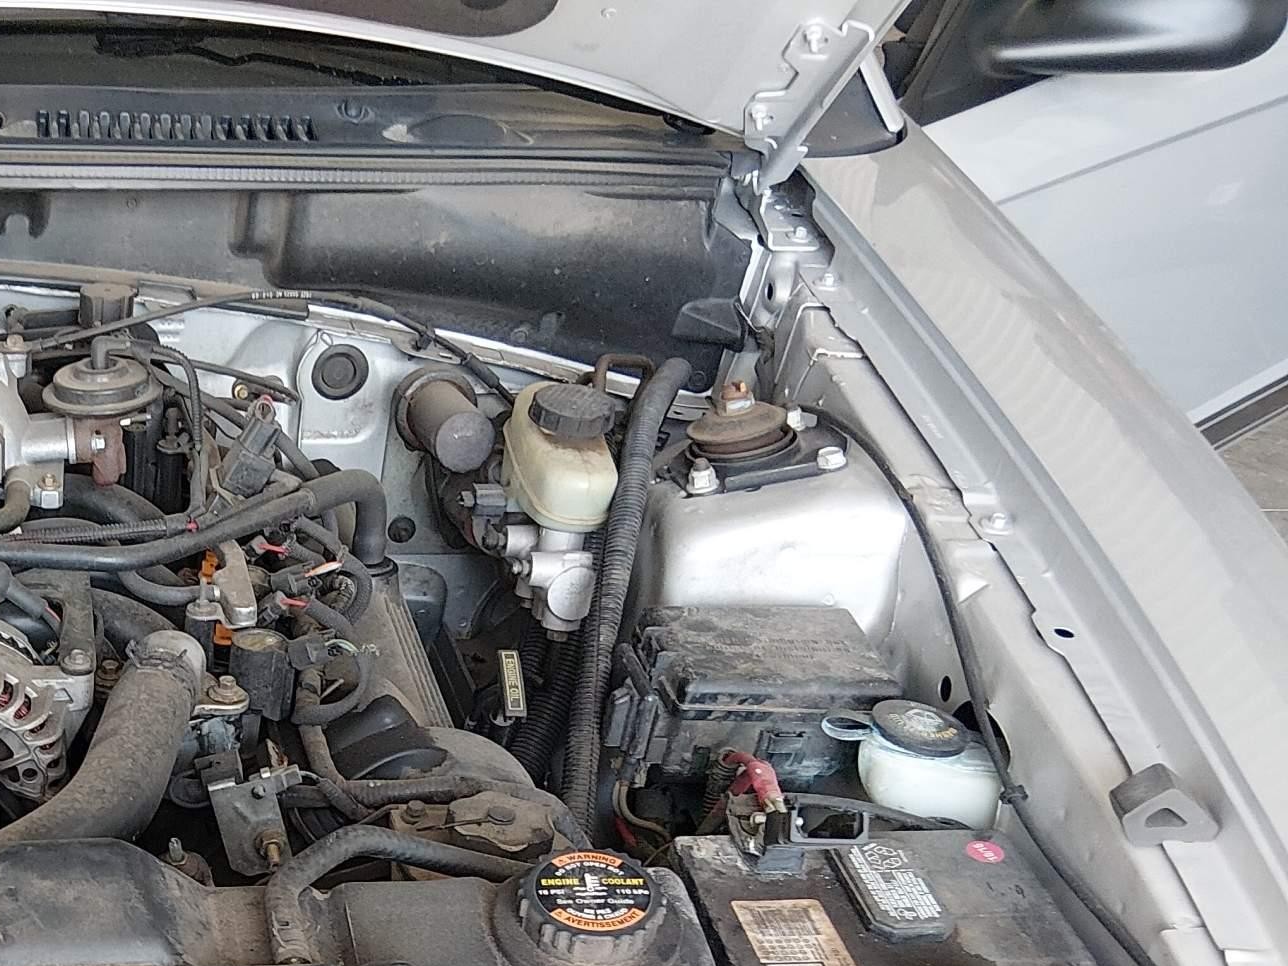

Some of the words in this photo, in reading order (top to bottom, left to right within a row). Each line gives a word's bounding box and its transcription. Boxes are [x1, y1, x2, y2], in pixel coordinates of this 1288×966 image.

[505, 658, 518, 686] ENGINE
[510, 687, 520, 702] OIL
[567, 853, 617, 865] WARNING
[555, 868, 566, 877] DO
[601, 878, 645, 886] COOLANT
[565, 910, 641, 928] AVERTISSEMENT
